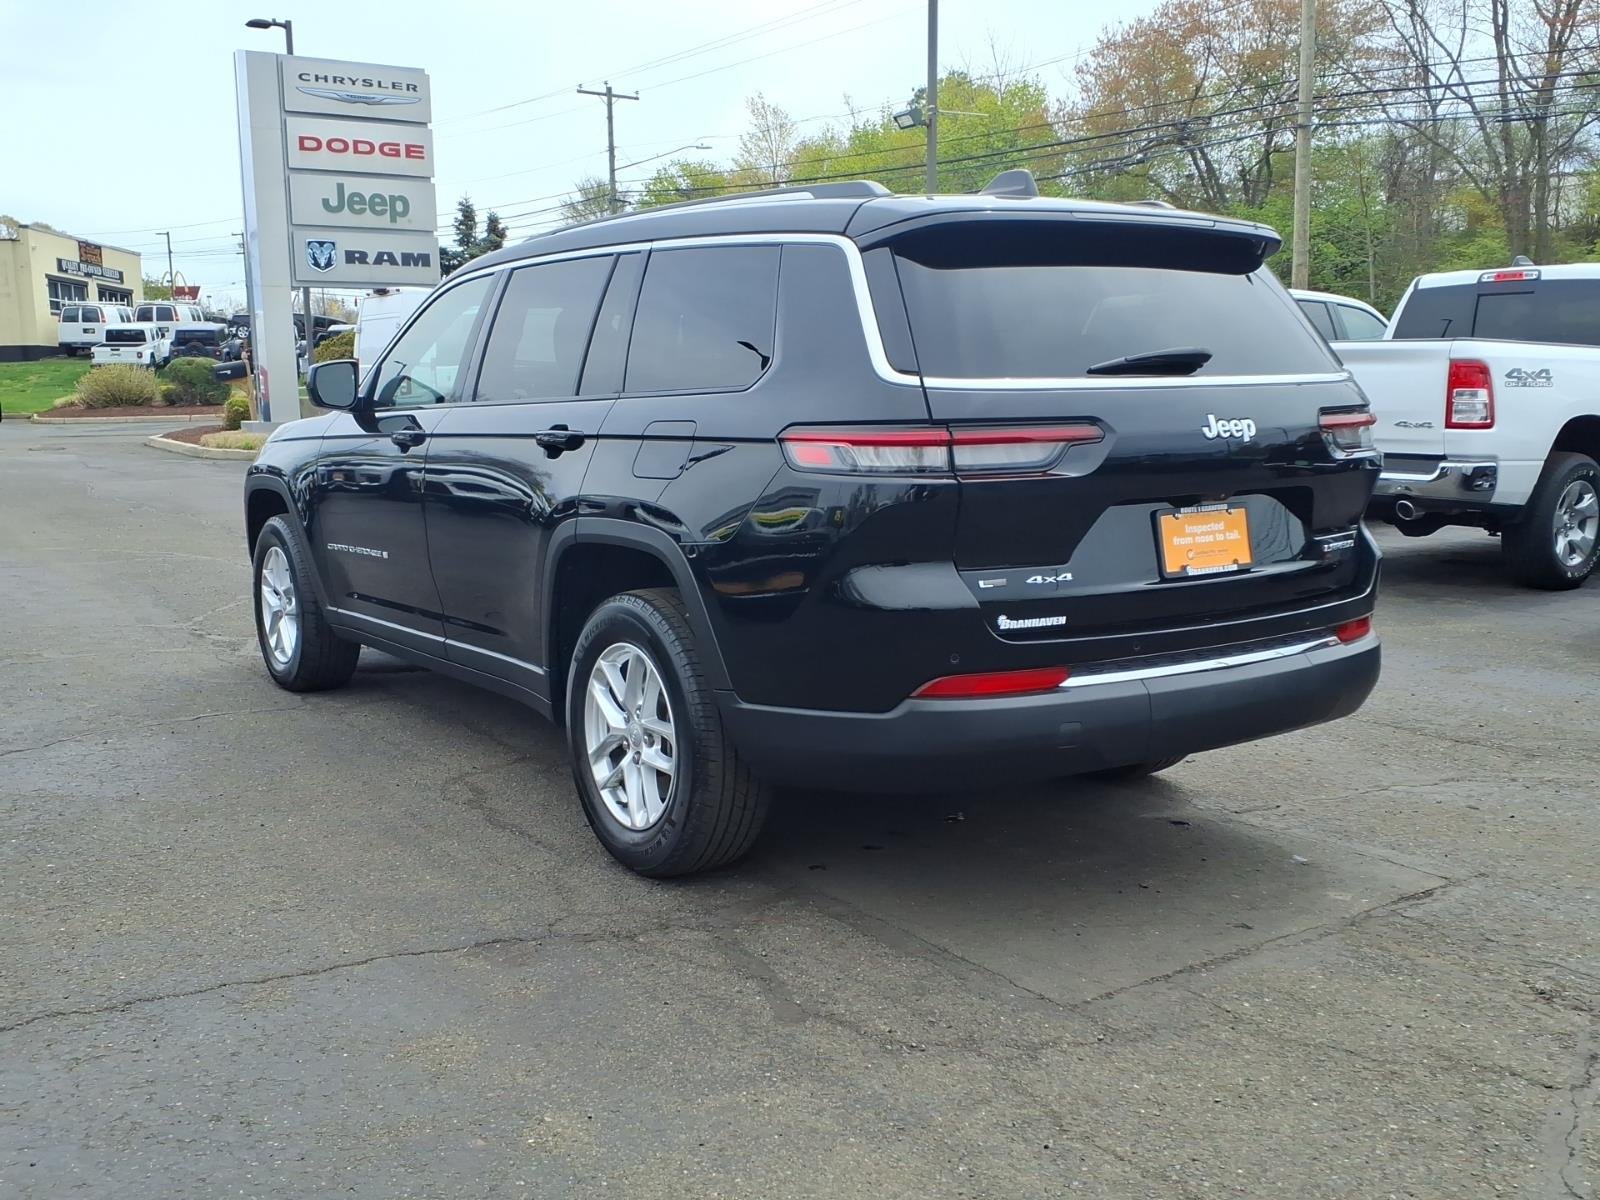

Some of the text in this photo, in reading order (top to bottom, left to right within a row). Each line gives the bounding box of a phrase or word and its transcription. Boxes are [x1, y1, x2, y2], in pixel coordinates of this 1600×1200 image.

[298, 72, 419, 92] CHRYSLER
[298, 135, 426, 160] DODGE
[321, 182, 410, 224] Jeep
[344, 249, 432, 268] RAM
[1504, 367, 1554, 381] 4x4
[1201, 414, 1256, 442] Jeep
[1393, 420, 1435, 429] 4x4
[1184, 521, 1225, 534] Inspected
[1173, 529, 1241, 546] from nose to tail.
[1025, 572, 1074, 584] 4x4
[999, 615, 1067, 630] BRANHAVEN
